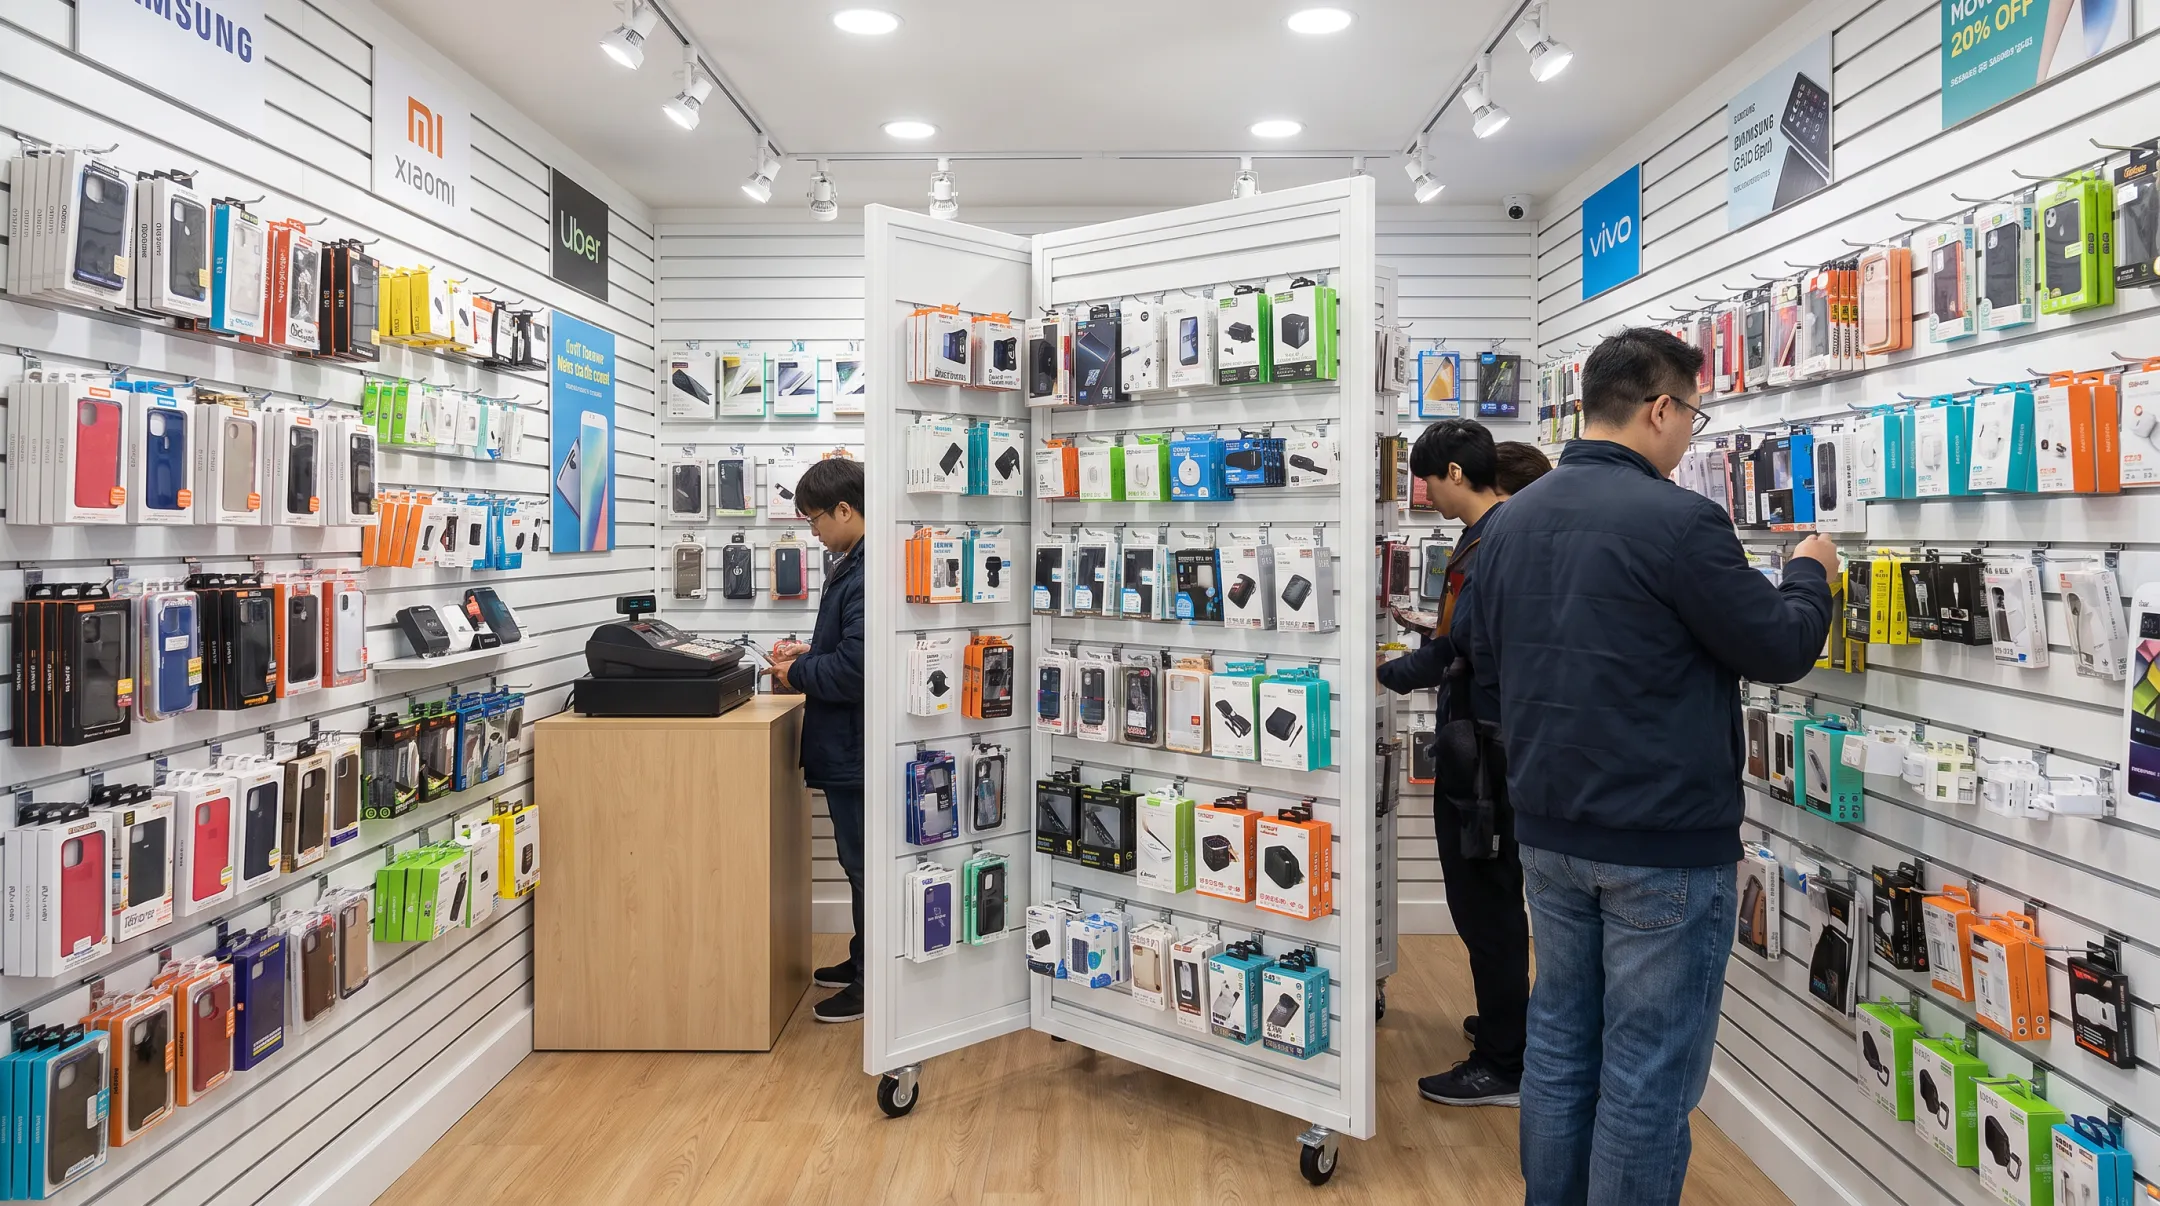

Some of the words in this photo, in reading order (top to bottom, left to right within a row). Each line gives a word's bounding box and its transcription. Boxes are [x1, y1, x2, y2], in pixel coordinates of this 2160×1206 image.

[1951, 15, 1991, 58] 20%
[1995, 0, 2033, 31] OFF
[560, 210, 601, 264] Uber
[1590, 215, 1632, 258] vivo
